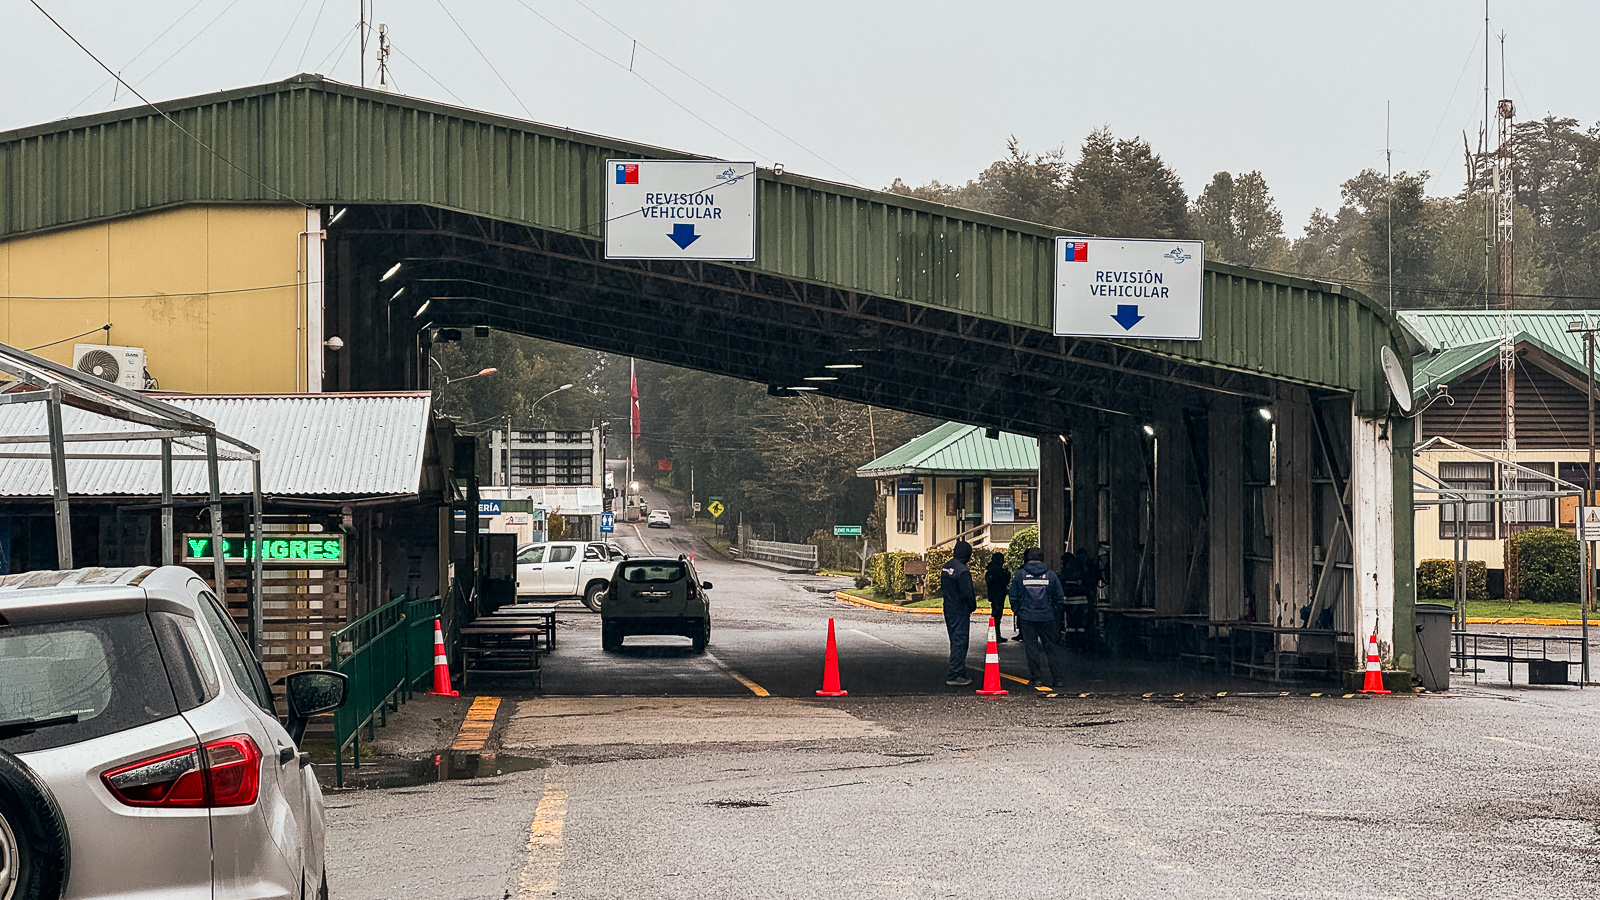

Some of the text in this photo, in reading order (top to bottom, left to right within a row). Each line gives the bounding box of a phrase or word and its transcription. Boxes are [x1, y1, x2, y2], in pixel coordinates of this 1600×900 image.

[646, 191, 714, 206] REVISIÓN
[641, 206, 722, 219] VEHICULAR
[1096, 270, 1163, 284] REVISIÓN
[1090, 284, 1169, 299] VEHICULAR
